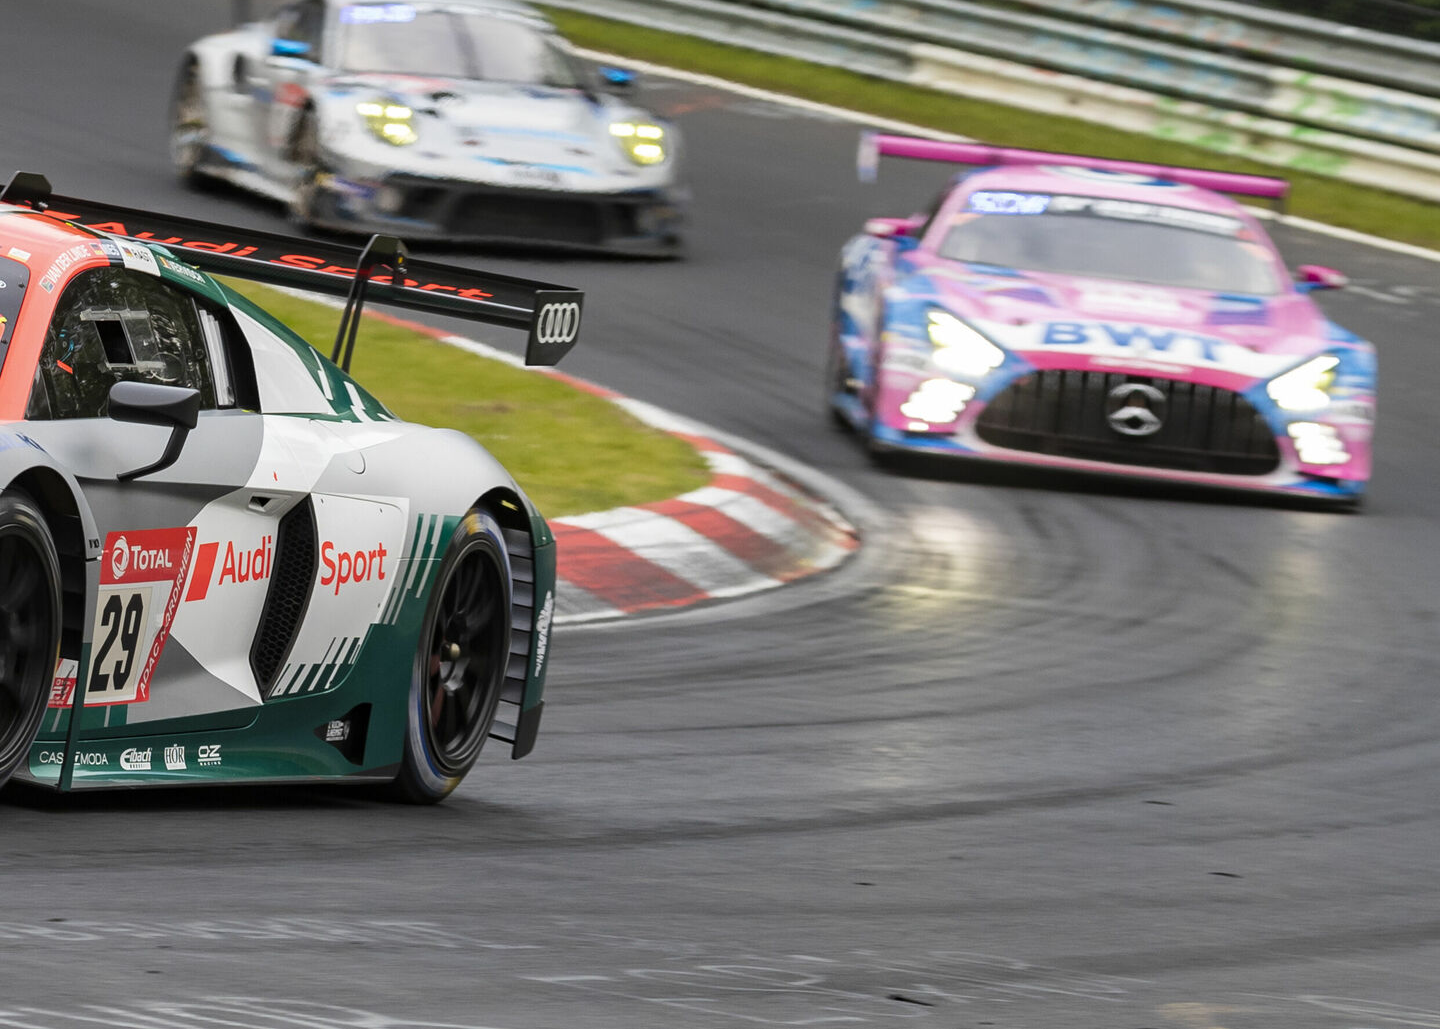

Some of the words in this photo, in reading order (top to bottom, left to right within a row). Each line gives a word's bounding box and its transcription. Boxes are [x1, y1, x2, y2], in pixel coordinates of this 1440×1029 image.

[69, 243, 92, 264] LINDE
[84, 221, 259, 257] Audi
[1042, 321, 1222, 362] BWT
[218, 535, 271, 586] Audi
[320, 541, 387, 596] Sport
[88, 593, 144, 693] 29
[140, 642, 160, 699] ADAC
[120, 747, 153, 770] Eibach
